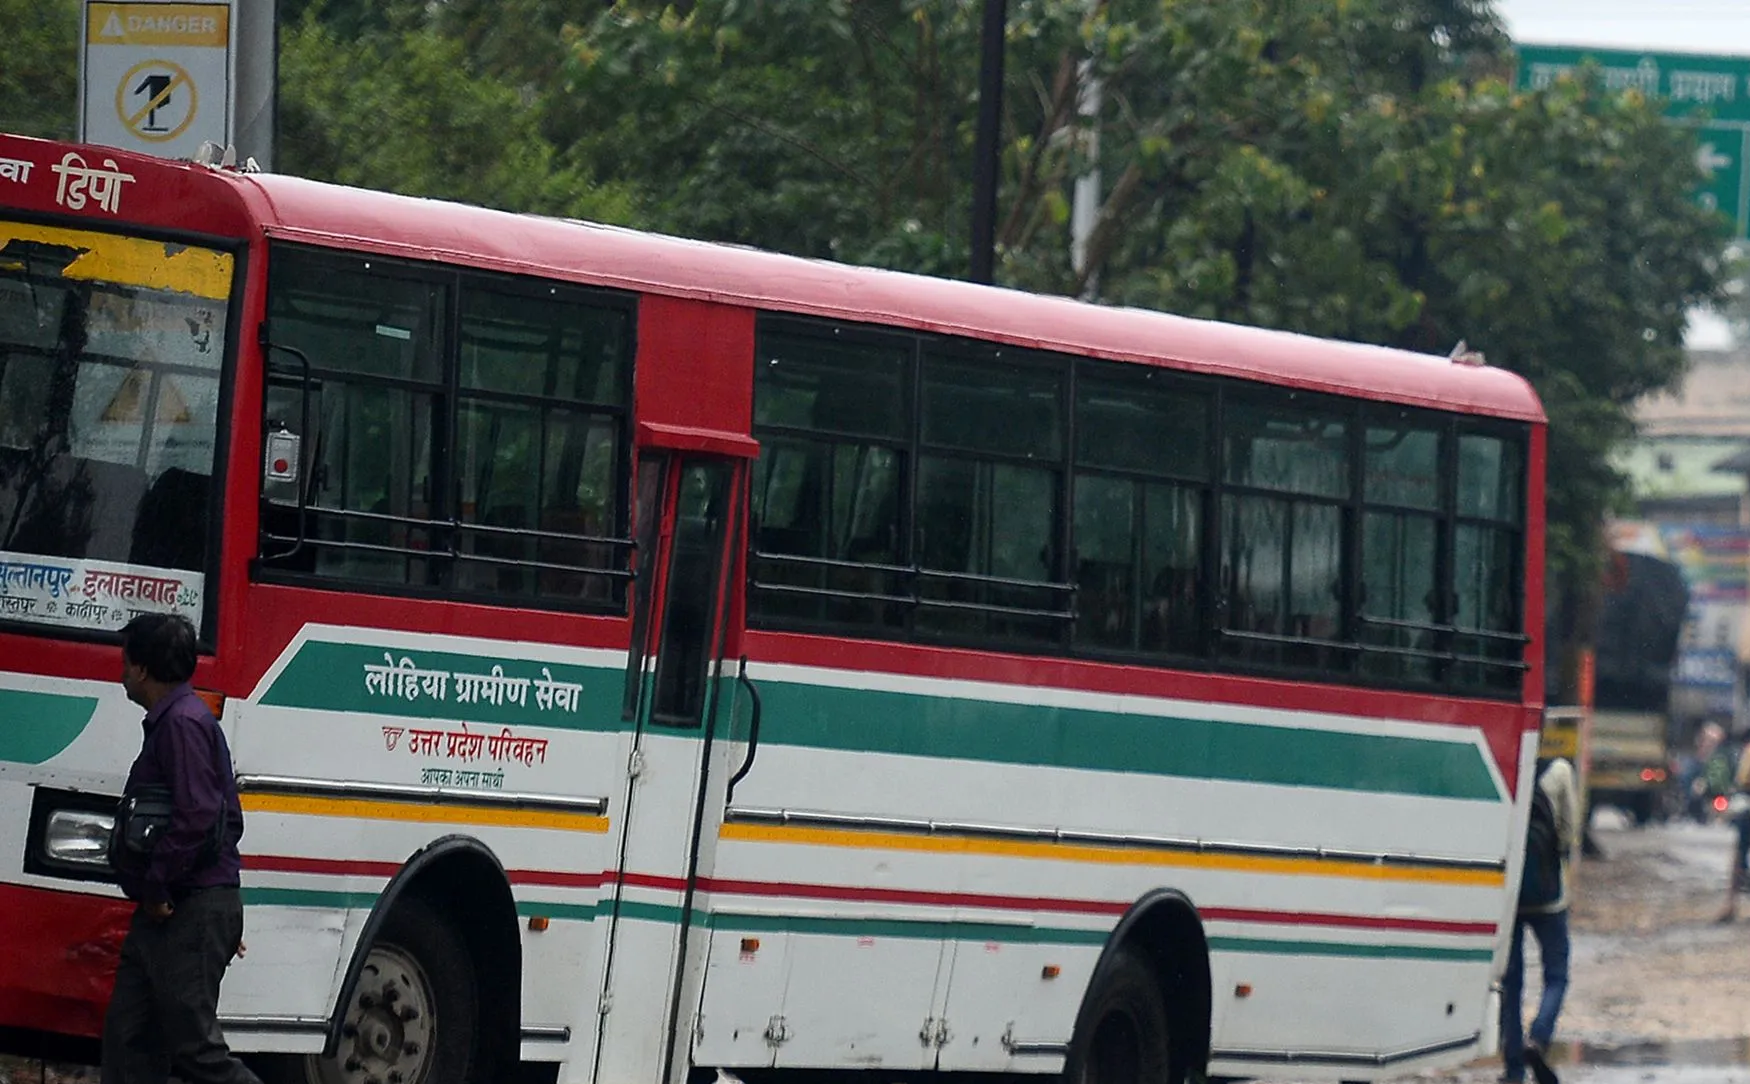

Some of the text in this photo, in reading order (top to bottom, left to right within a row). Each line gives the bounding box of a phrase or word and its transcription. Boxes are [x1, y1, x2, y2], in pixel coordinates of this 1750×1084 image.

[128, 14, 216, 34] DANGER
[51, 152, 136, 213] डिपो
[82, 570, 182, 605] इलाहाबाद
[363, 652, 582, 712] लोहिया ग्रामीण सेवा
[408, 721, 548, 767] उत्तर प्रदेश परिवहन
[421, 768, 453, 785] आपका
[455, 770, 480, 788] अपना
